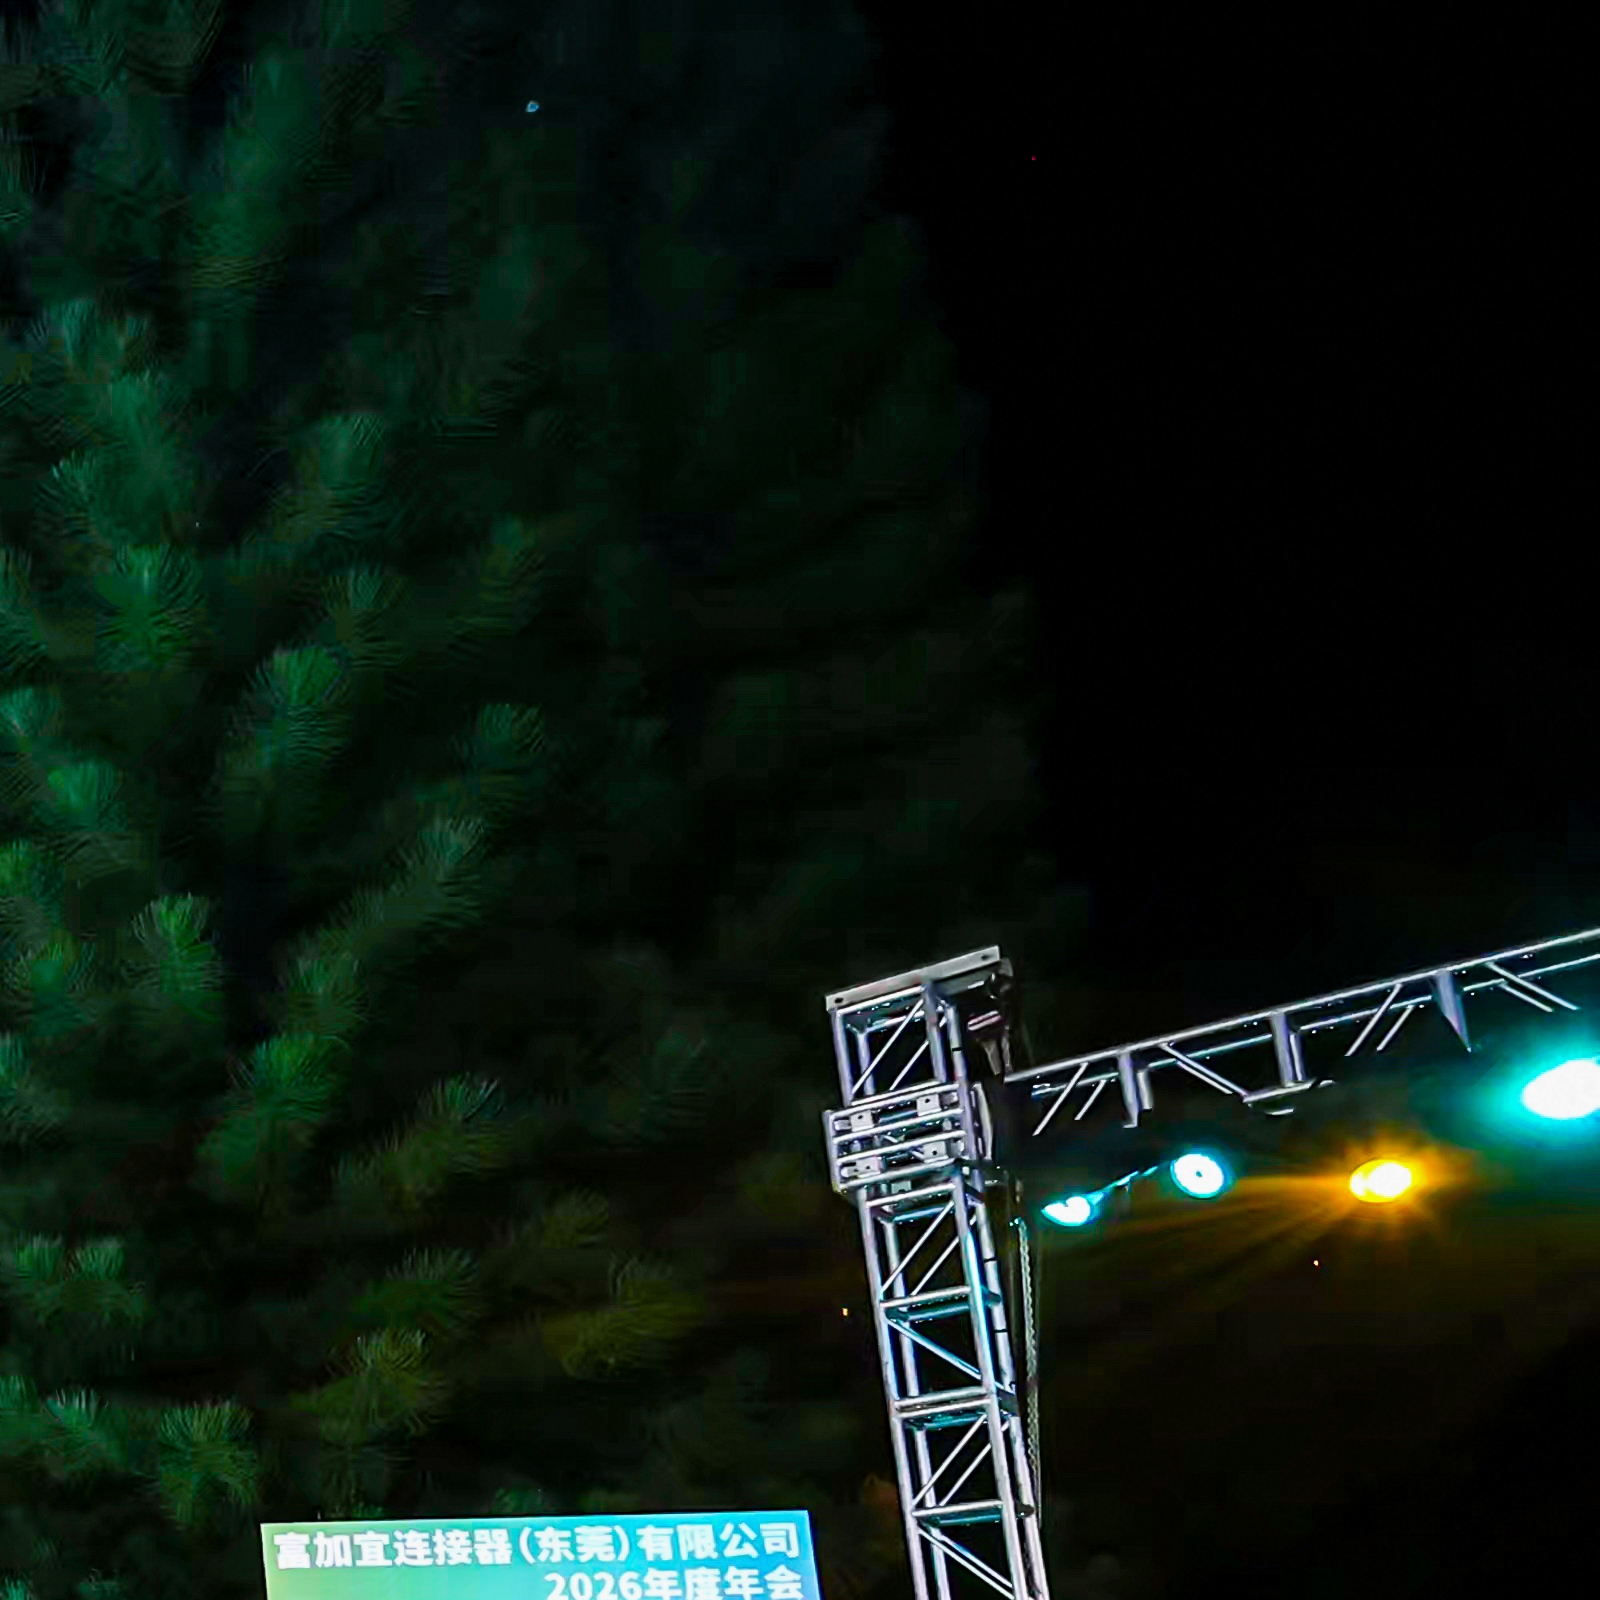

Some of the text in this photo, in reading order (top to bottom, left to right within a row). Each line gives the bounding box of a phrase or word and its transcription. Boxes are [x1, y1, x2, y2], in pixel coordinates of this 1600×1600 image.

[273, 1522, 799, 1569] 富加宜连接器（东莞）有限公司
